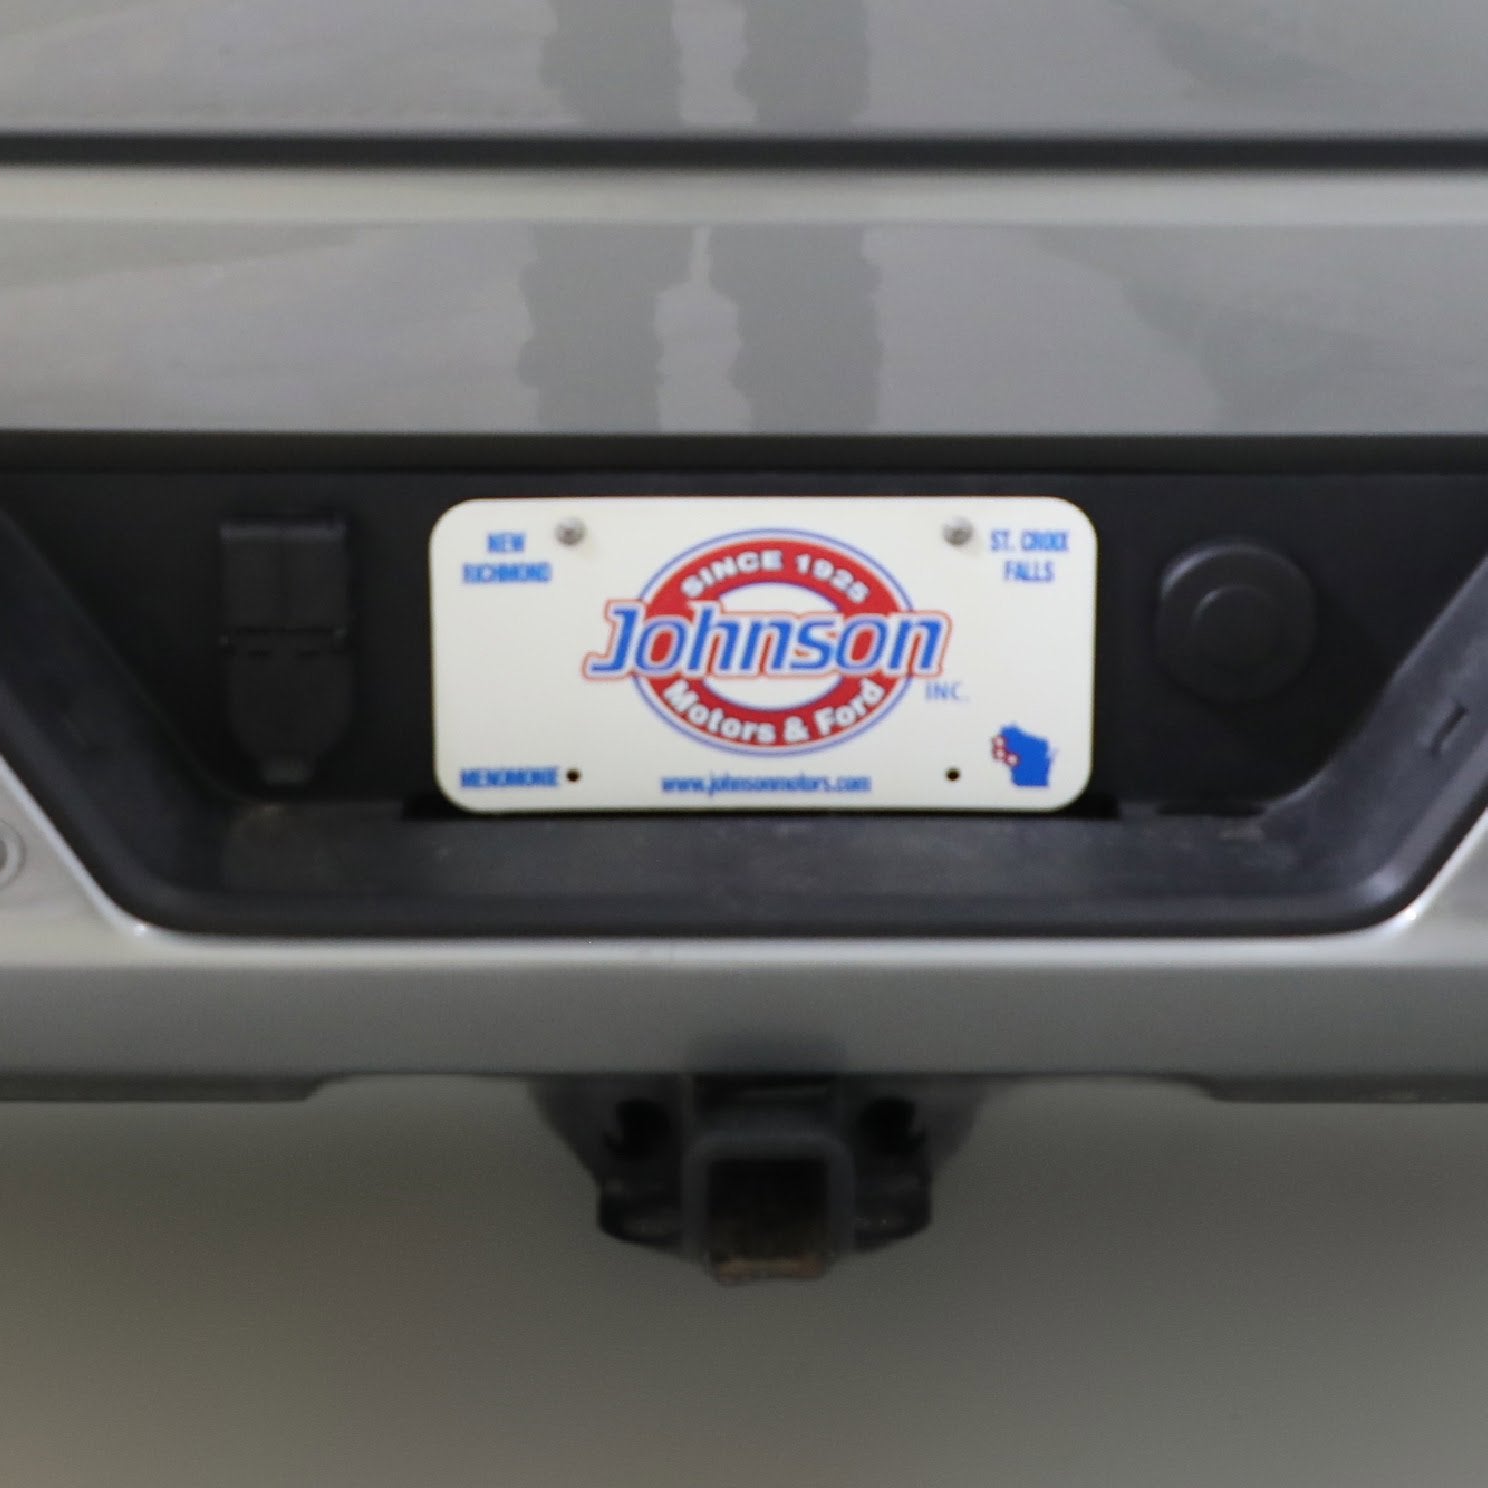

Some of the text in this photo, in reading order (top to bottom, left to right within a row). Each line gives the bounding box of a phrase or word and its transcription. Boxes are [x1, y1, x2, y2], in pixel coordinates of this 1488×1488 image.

[681, 550, 782, 598] SINCE
[588, 604, 944, 675] Johnson
[662, 678, 885, 745] Motors & Ford
[924, 682, 969, 702] INC.
